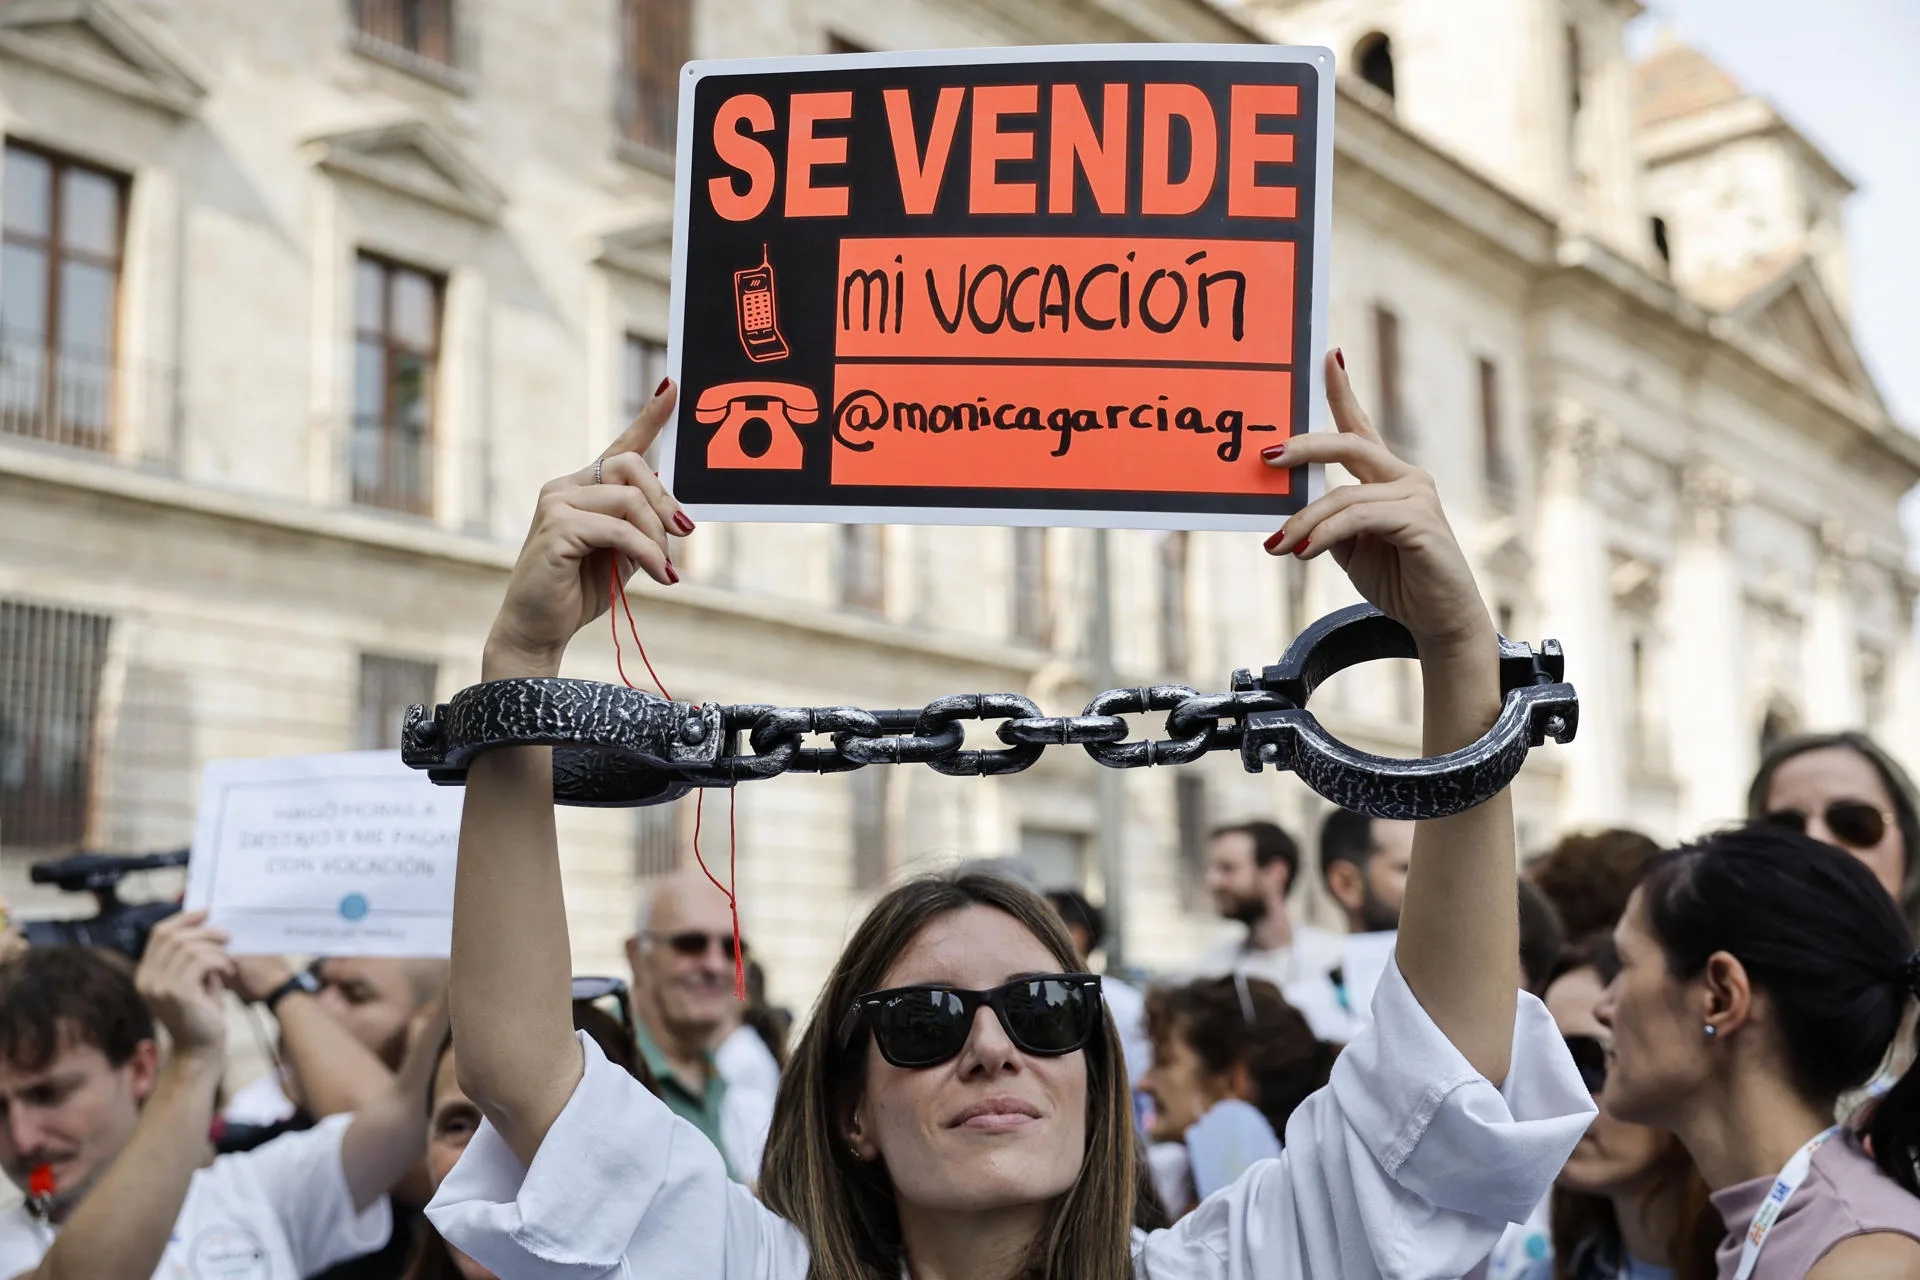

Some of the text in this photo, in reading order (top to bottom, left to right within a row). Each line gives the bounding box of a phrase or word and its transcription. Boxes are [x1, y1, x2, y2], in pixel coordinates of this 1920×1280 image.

[708, 83, 1299, 222] SE VENDE
[842, 254, 905, 334] mi
